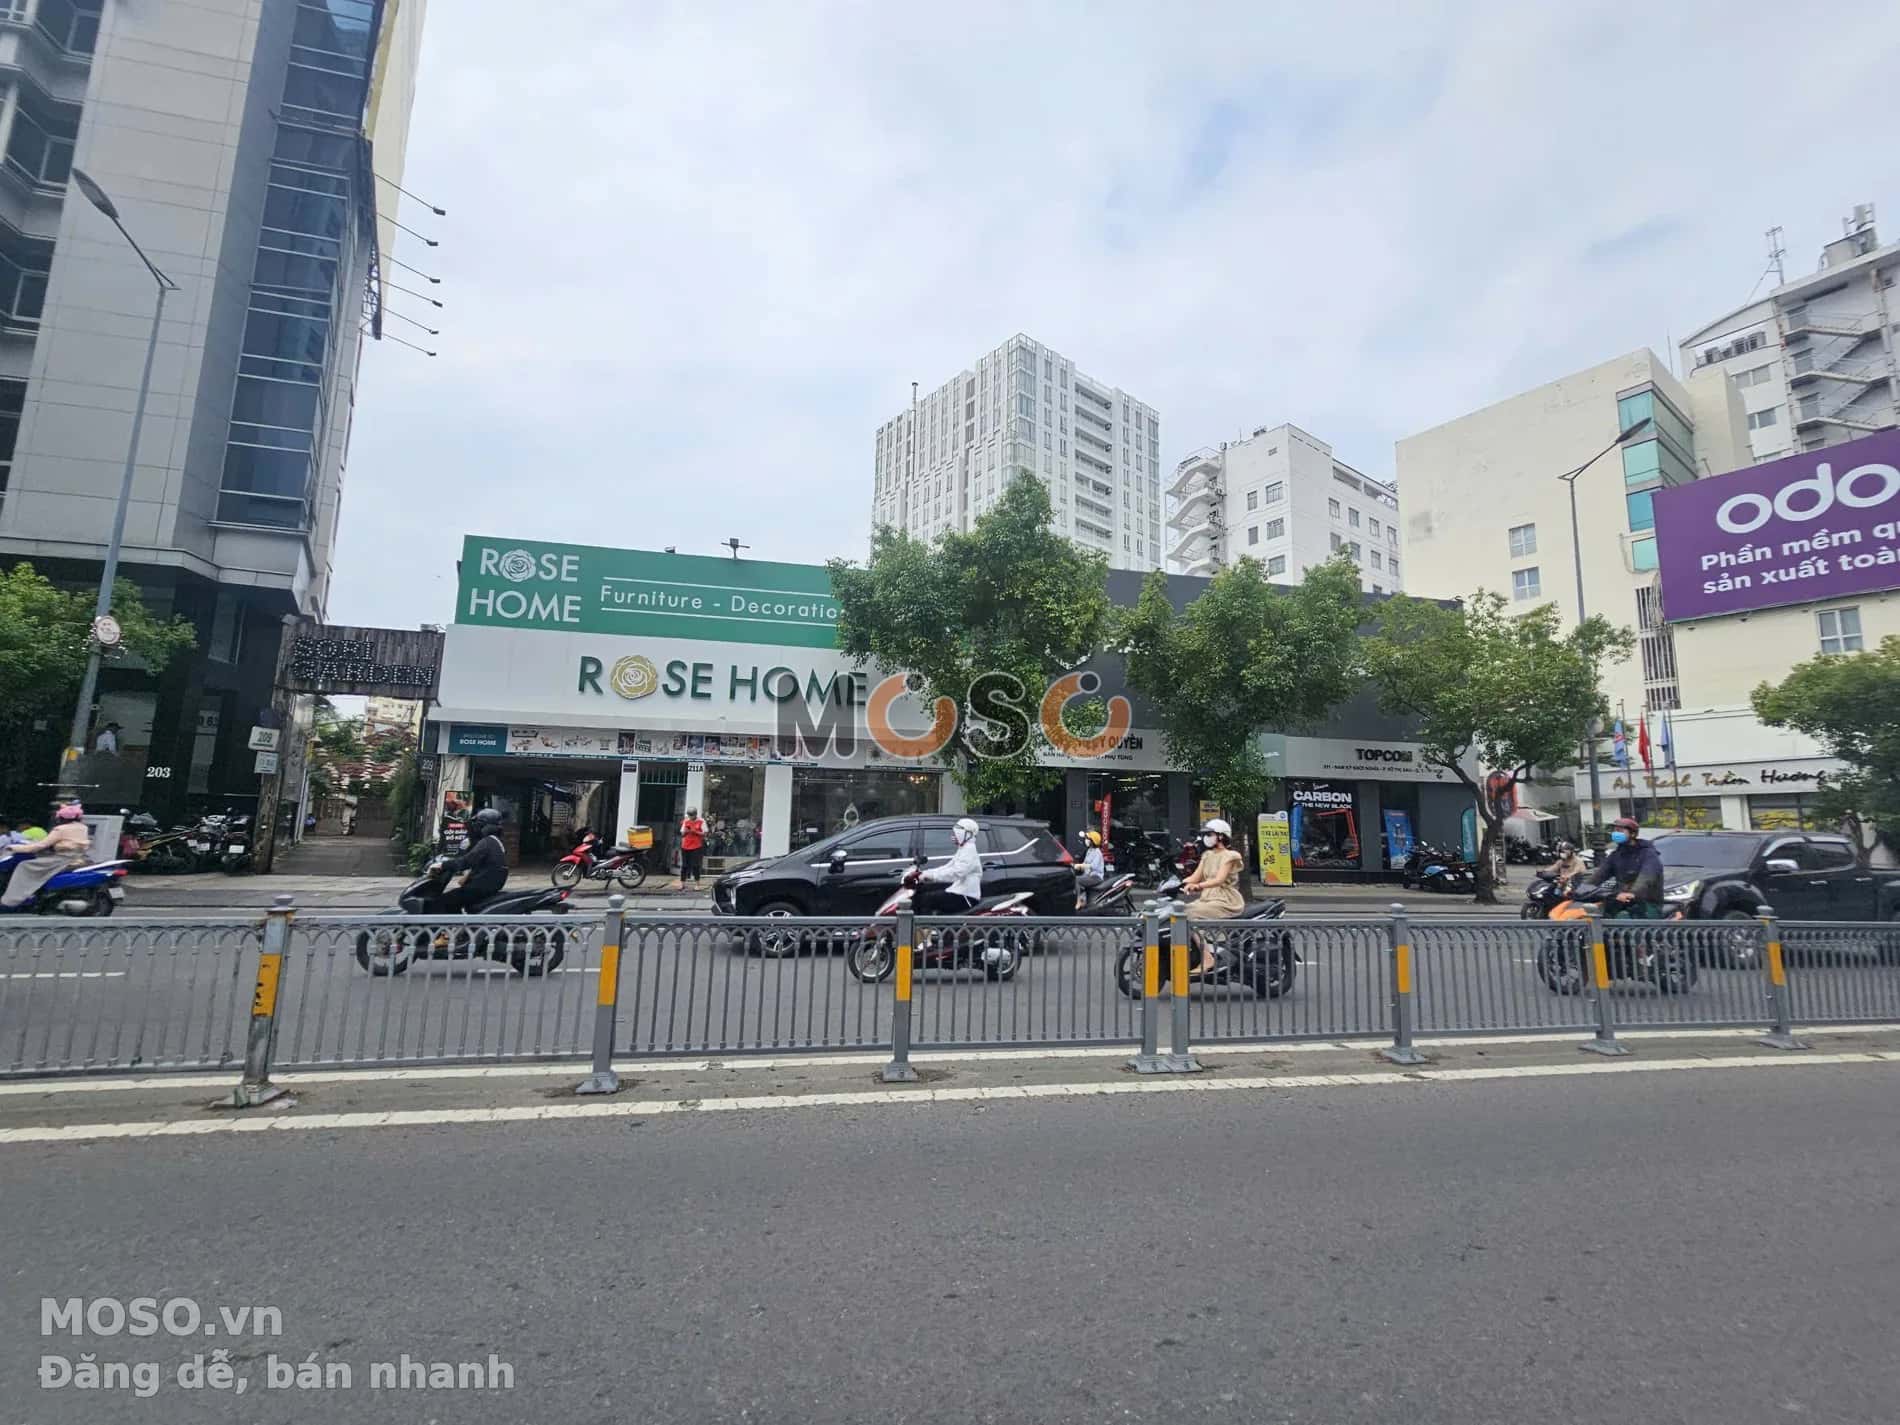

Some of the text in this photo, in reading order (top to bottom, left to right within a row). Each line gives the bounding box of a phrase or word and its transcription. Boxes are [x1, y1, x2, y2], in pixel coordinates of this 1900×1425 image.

[1701, 520, 1900, 571] Phần mềm q
[479, 548, 580, 583] ROSE
[1703, 546, 1900, 594] sản xuất toà
[469, 588, 582, 623] HOME
[600, 584, 703, 609] Furniture
[731, 595, 844, 619] Decoratio
[293, 660, 435, 686] GARDEN
[577, 655, 868, 707] ROSE HOME
[146, 766, 171, 779] 203
[1293, 790, 1352, 802] CARBON
